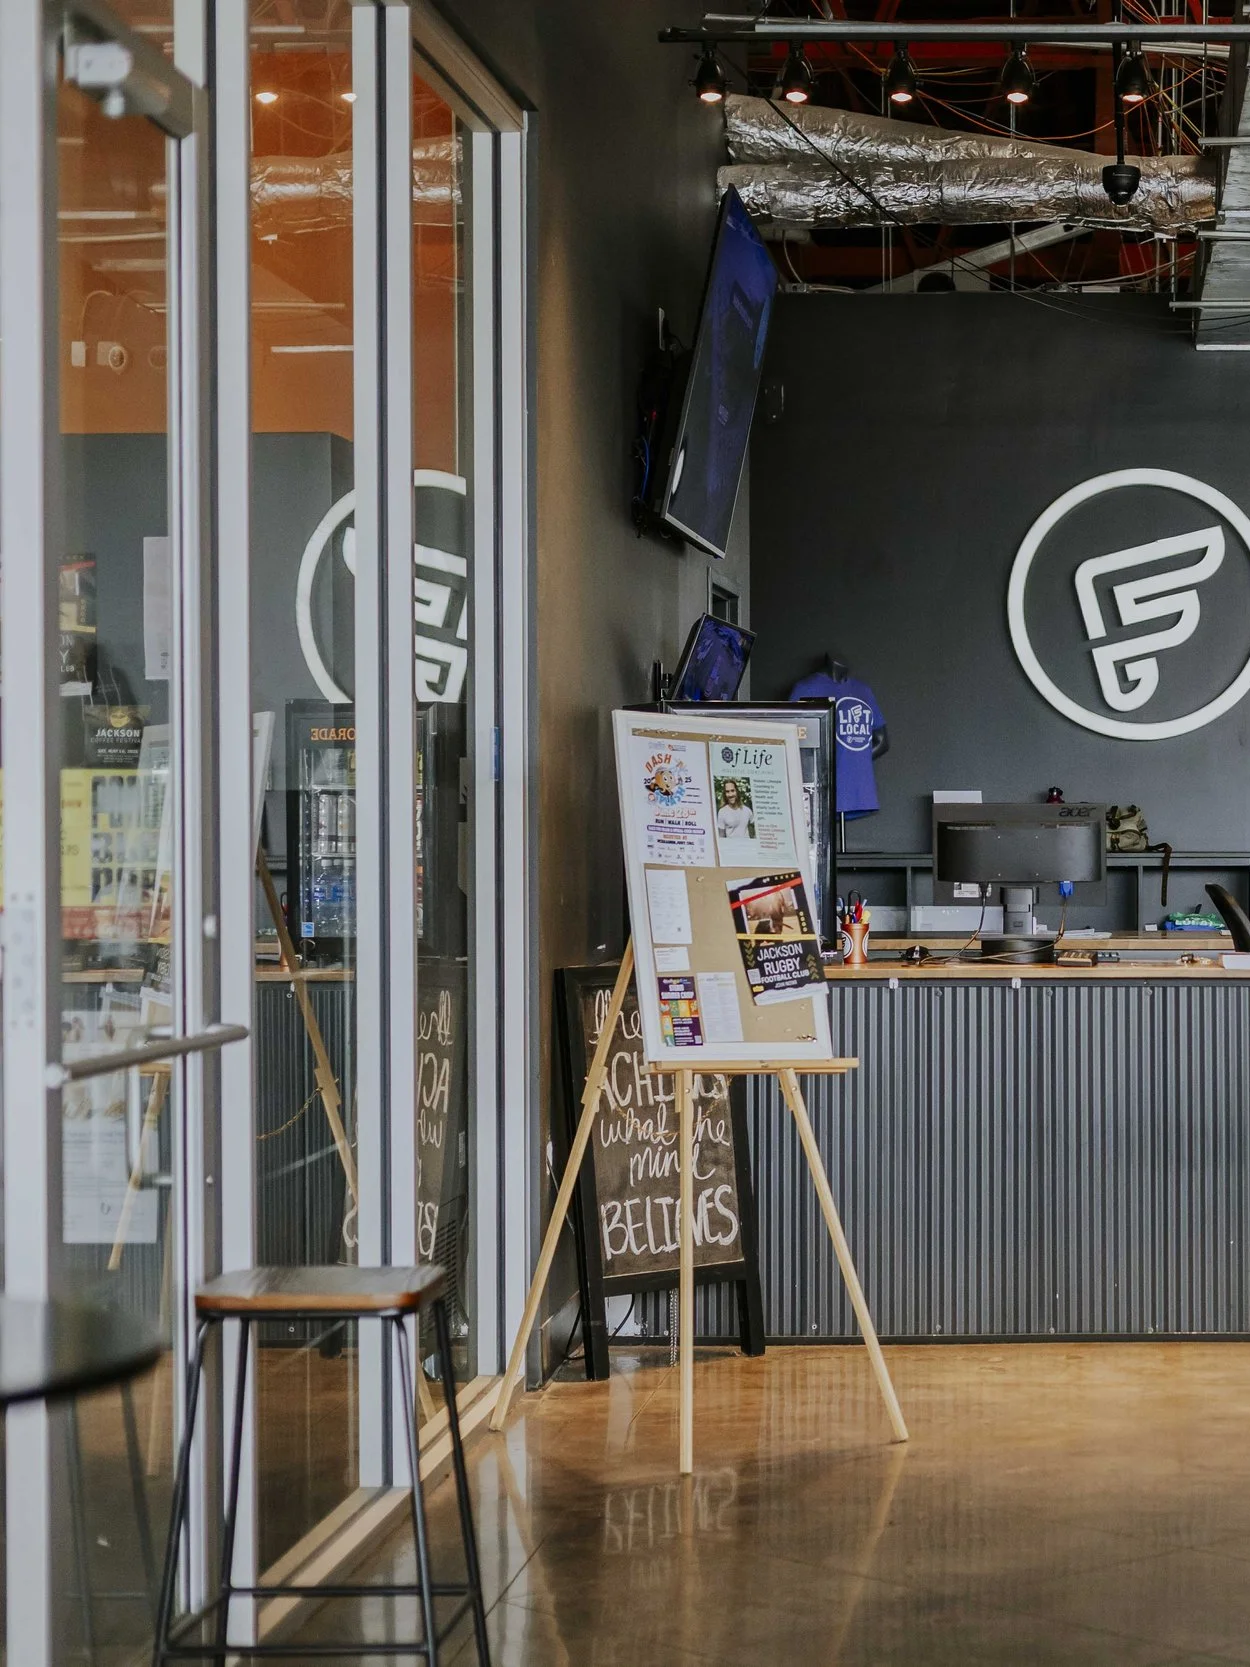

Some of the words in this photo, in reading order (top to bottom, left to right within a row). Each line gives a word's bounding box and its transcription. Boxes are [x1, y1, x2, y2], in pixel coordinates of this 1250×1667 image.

[95, 728, 140, 738] JACKSON
[839, 723, 871, 736] LOCAL
[645, 753, 672, 774] DASH
[743, 749, 773, 769] Life
[1059, 807, 1097, 817] acer
[757, 942, 803, 961] JACKSON
[760, 970, 793, 984] FOOTBALL
[791, 968, 810, 979] CLUB
[763, 957, 801, 976] RUGBY
[601, 1103, 677, 1148] what
[691, 1105, 730, 1147] he
